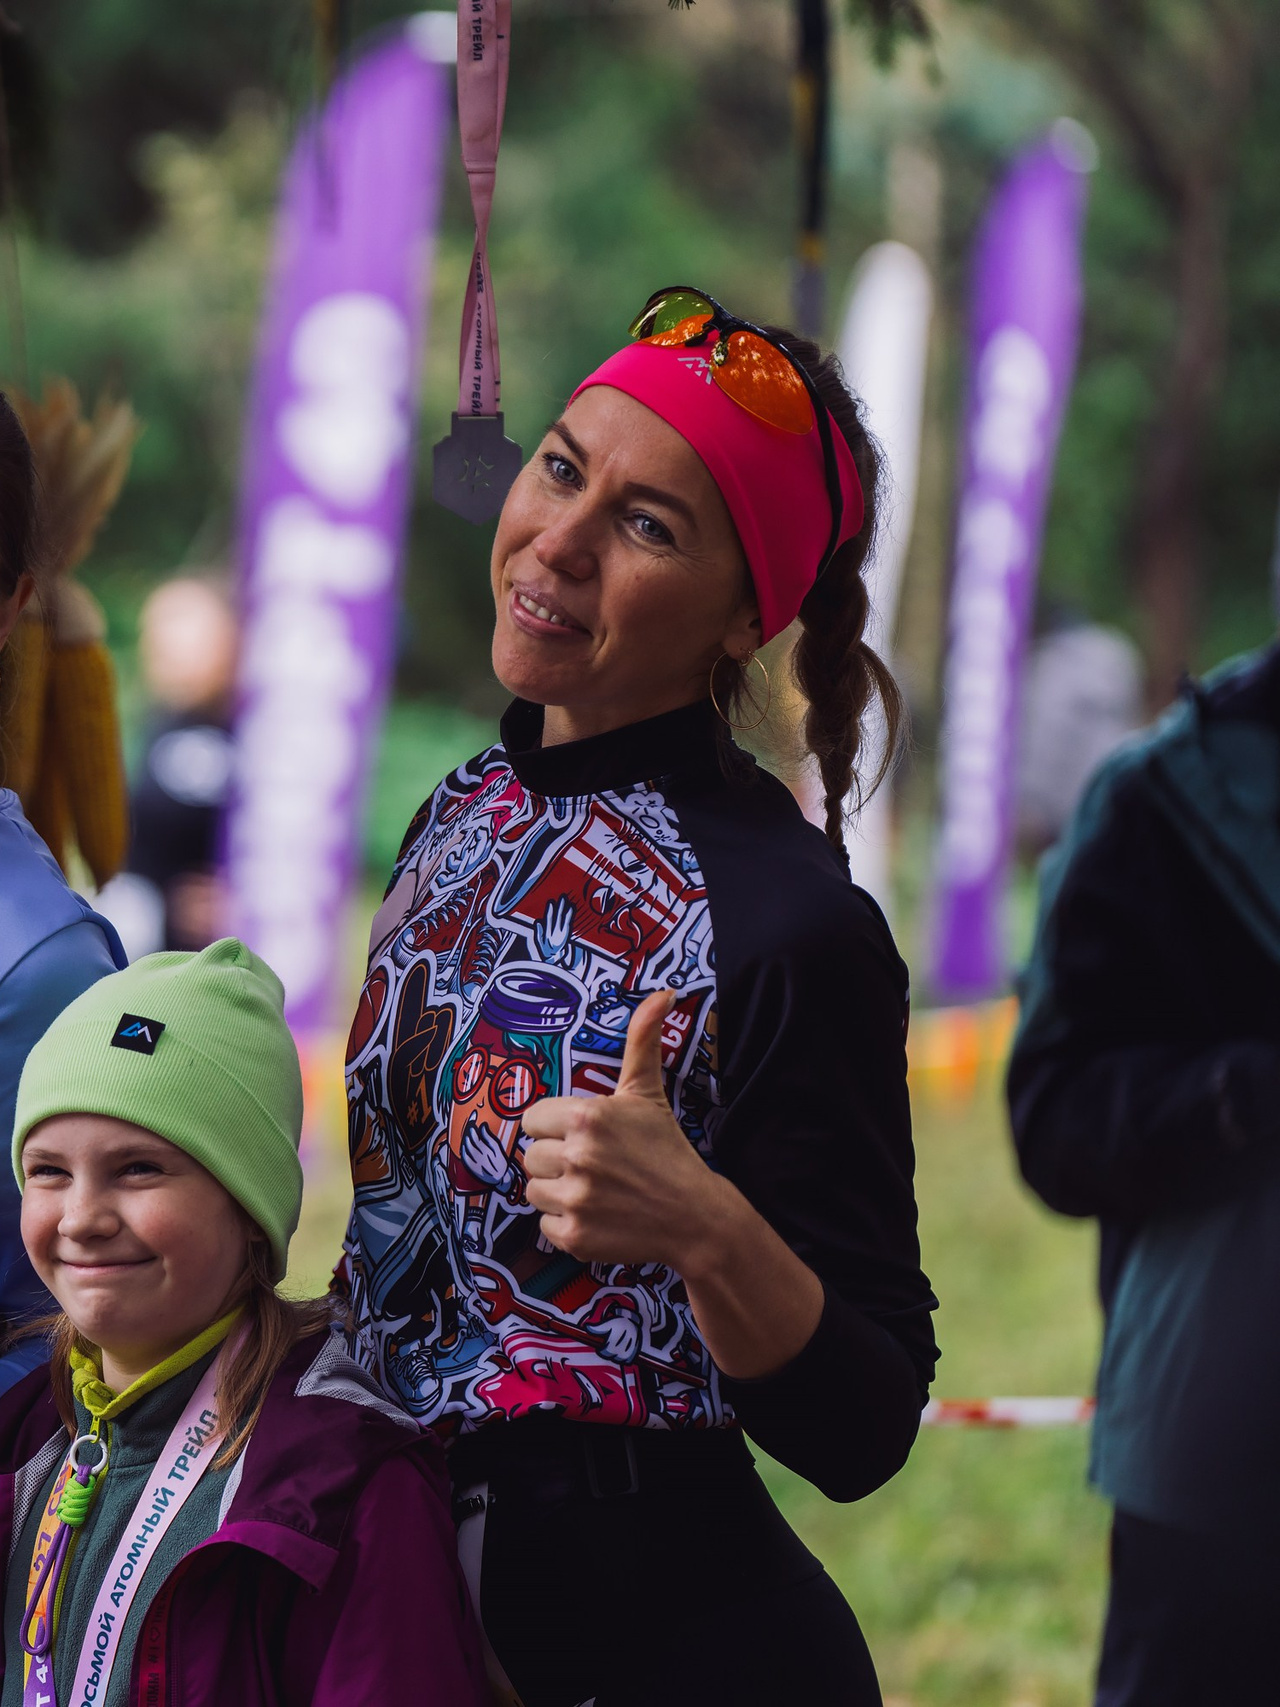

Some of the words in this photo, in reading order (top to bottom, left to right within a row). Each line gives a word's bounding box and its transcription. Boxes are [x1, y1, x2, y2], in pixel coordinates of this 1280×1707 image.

[472, 16, 485, 61] ТРЕЙЛ
[474, 302, 484, 370] АТОМНЫЙ
[406, 1090, 434, 1129] #1
[110, 1486, 176, 1608] АТОМНЫЙ
[167, 1409, 219, 1481] ТРЕЙЛ
